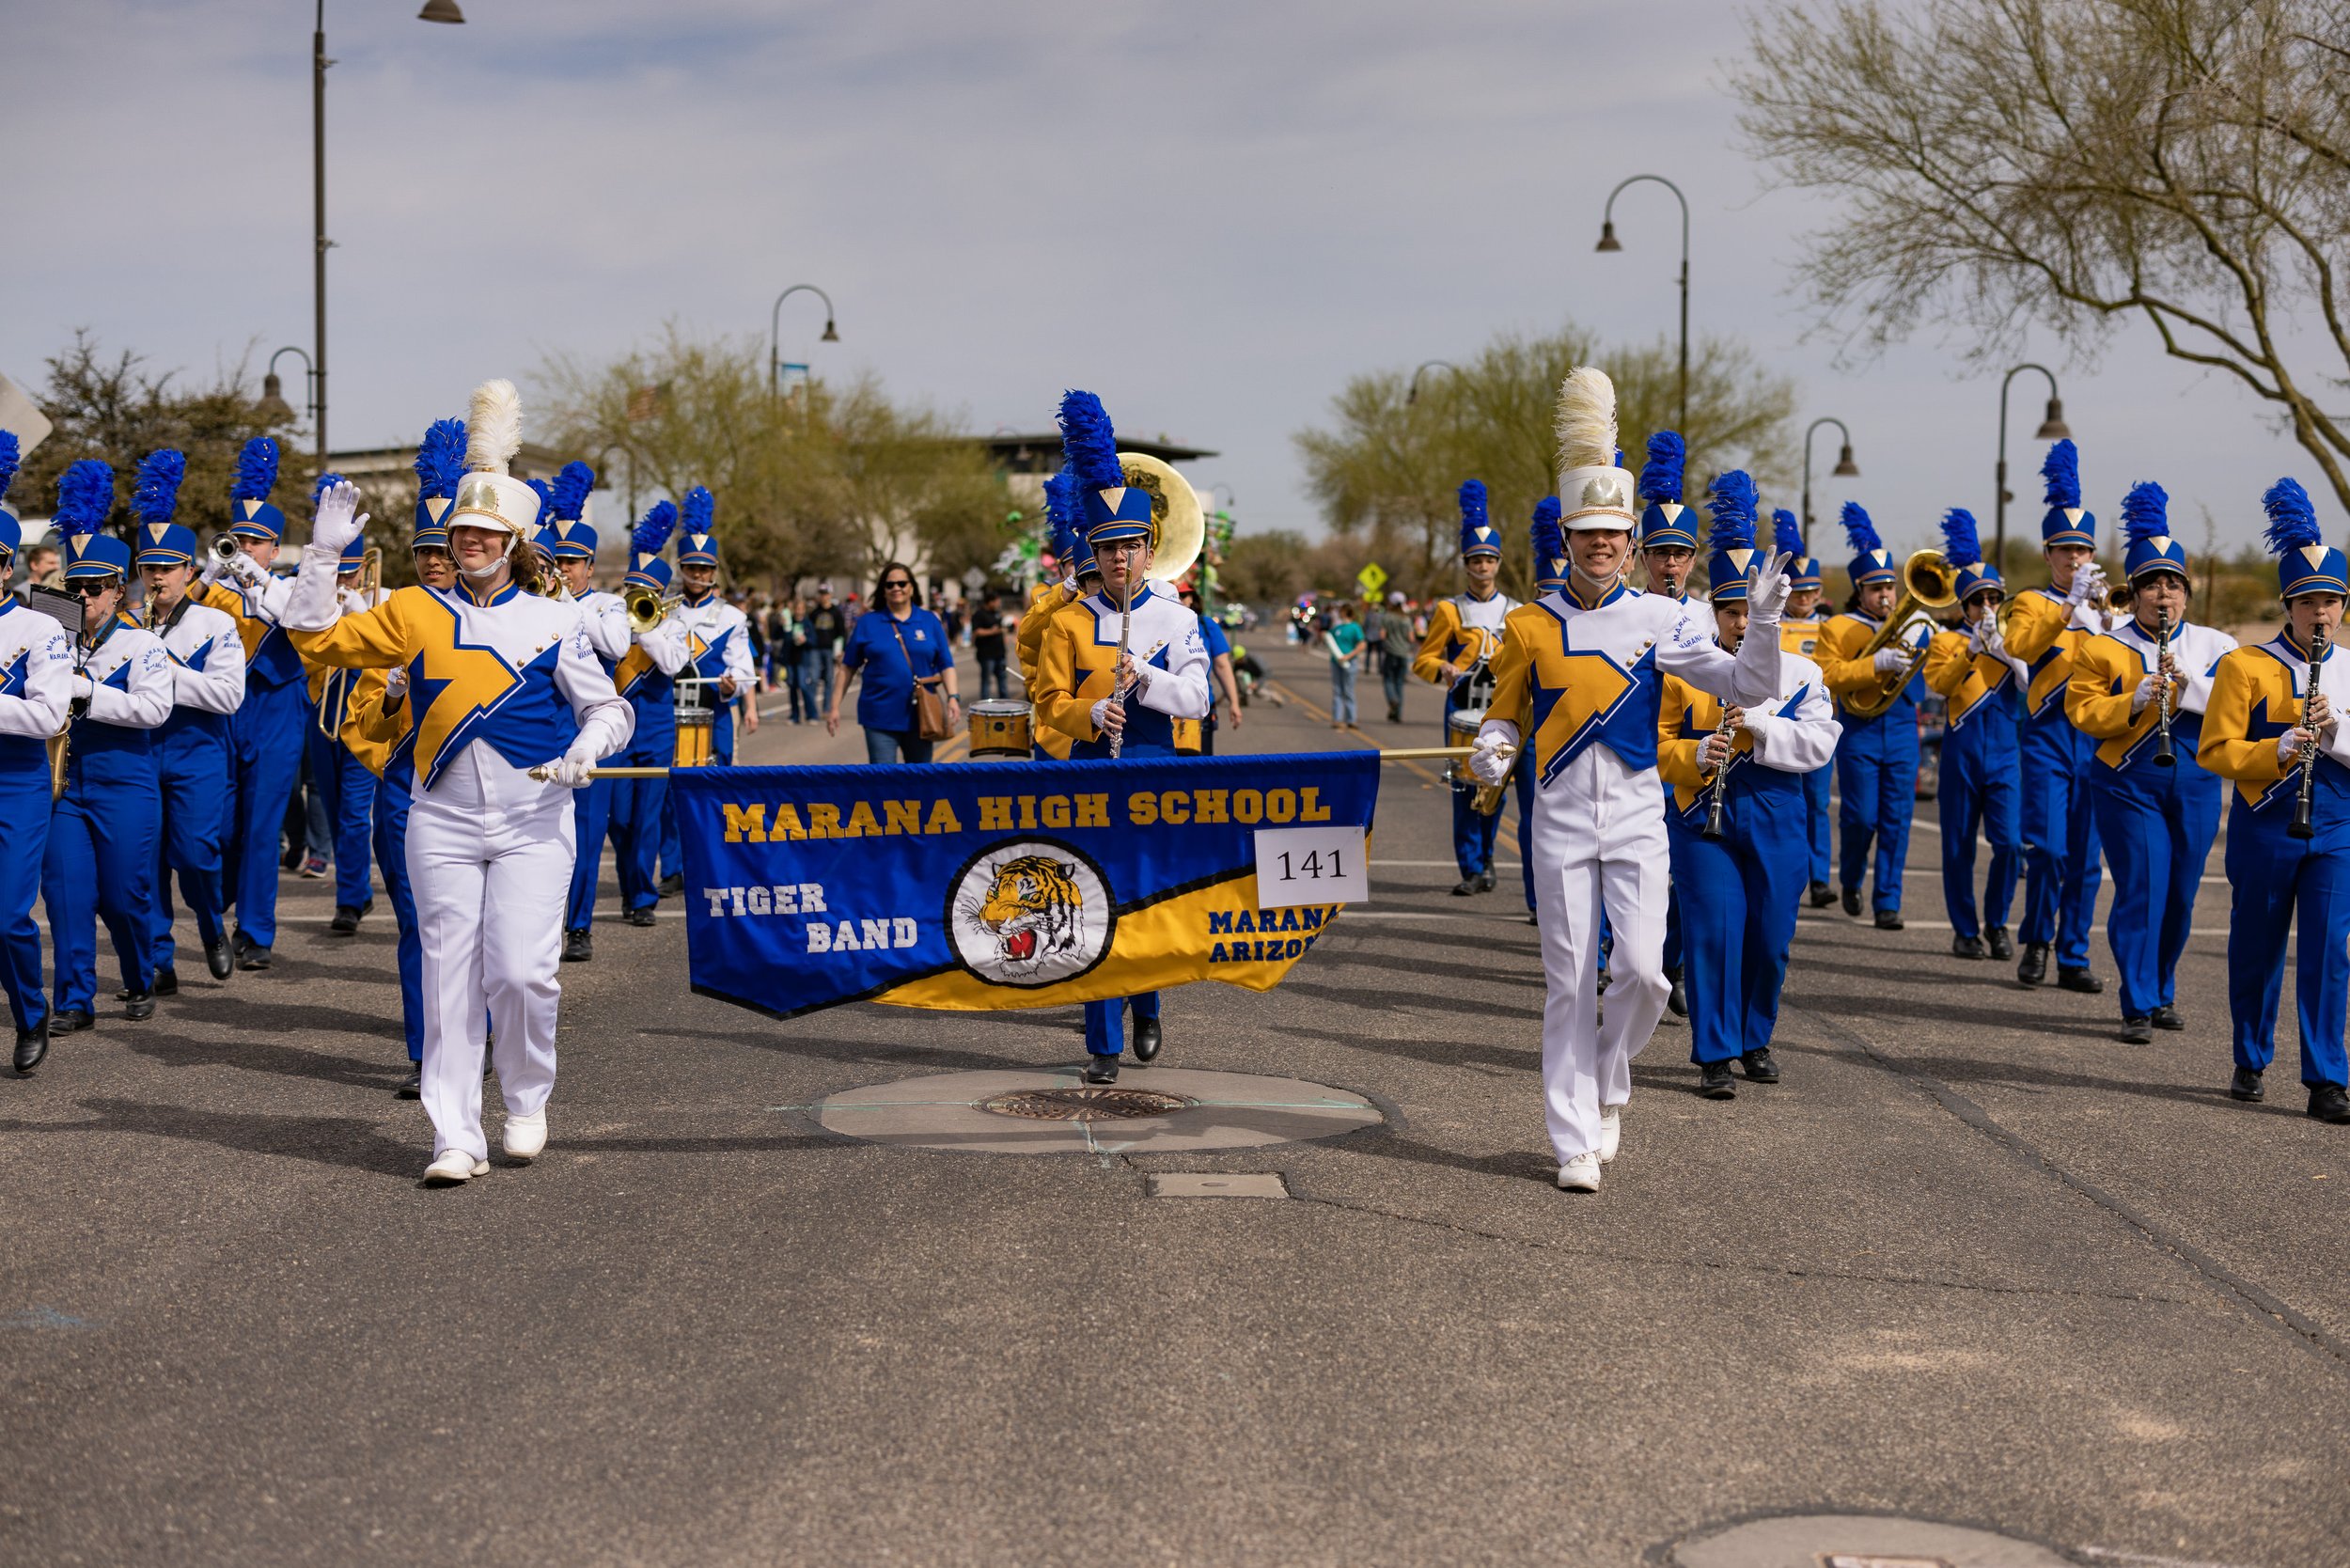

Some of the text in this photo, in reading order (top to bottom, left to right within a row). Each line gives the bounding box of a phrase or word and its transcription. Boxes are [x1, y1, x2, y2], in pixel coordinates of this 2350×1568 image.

[723, 787, 1331, 842] MARANA HIGH SCHOOL
[1277, 849, 1347, 881] 141
[704, 883, 828, 917] TIGER
[807, 917, 918, 953] BAND
